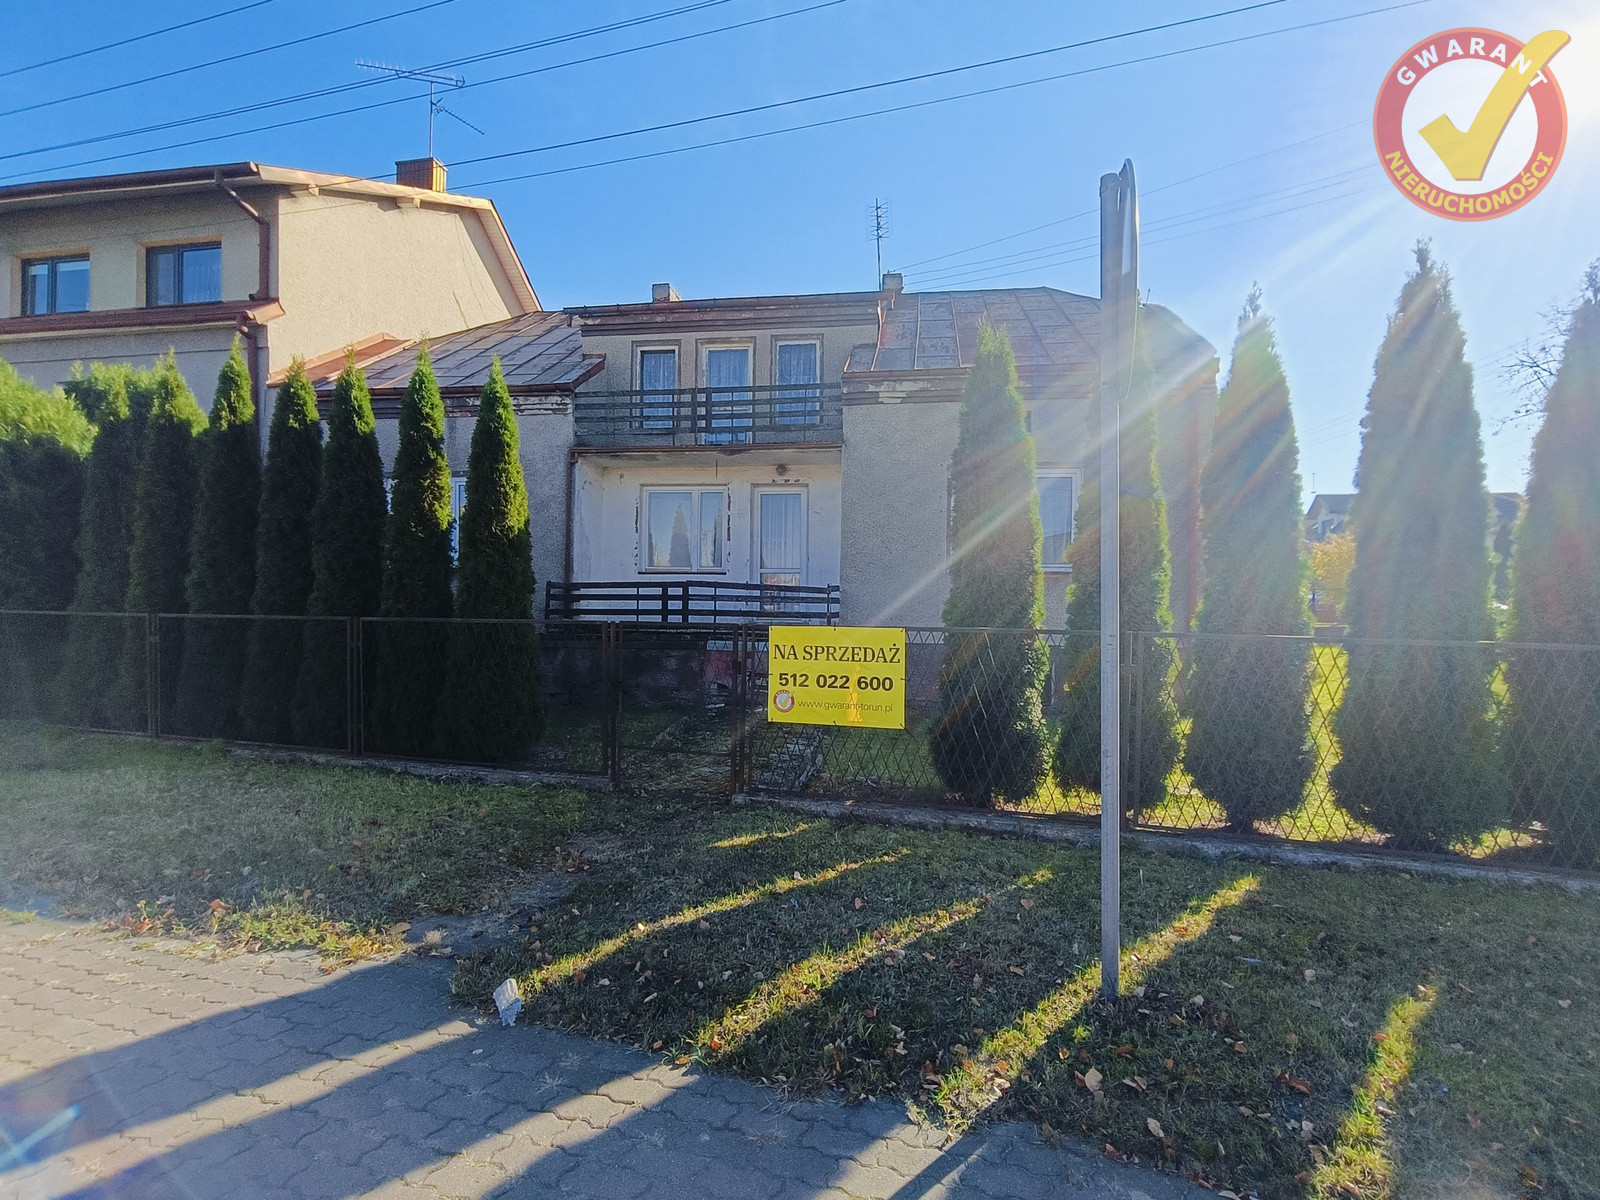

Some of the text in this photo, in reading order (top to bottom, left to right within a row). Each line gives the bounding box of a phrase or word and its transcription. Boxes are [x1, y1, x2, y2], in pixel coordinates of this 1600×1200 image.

[773, 643, 901, 664] NA SPRZEDAŻ
[779, 673, 894, 691] 512 022 600
[798, 700, 893, 712] www.gwarant-torun.pl
